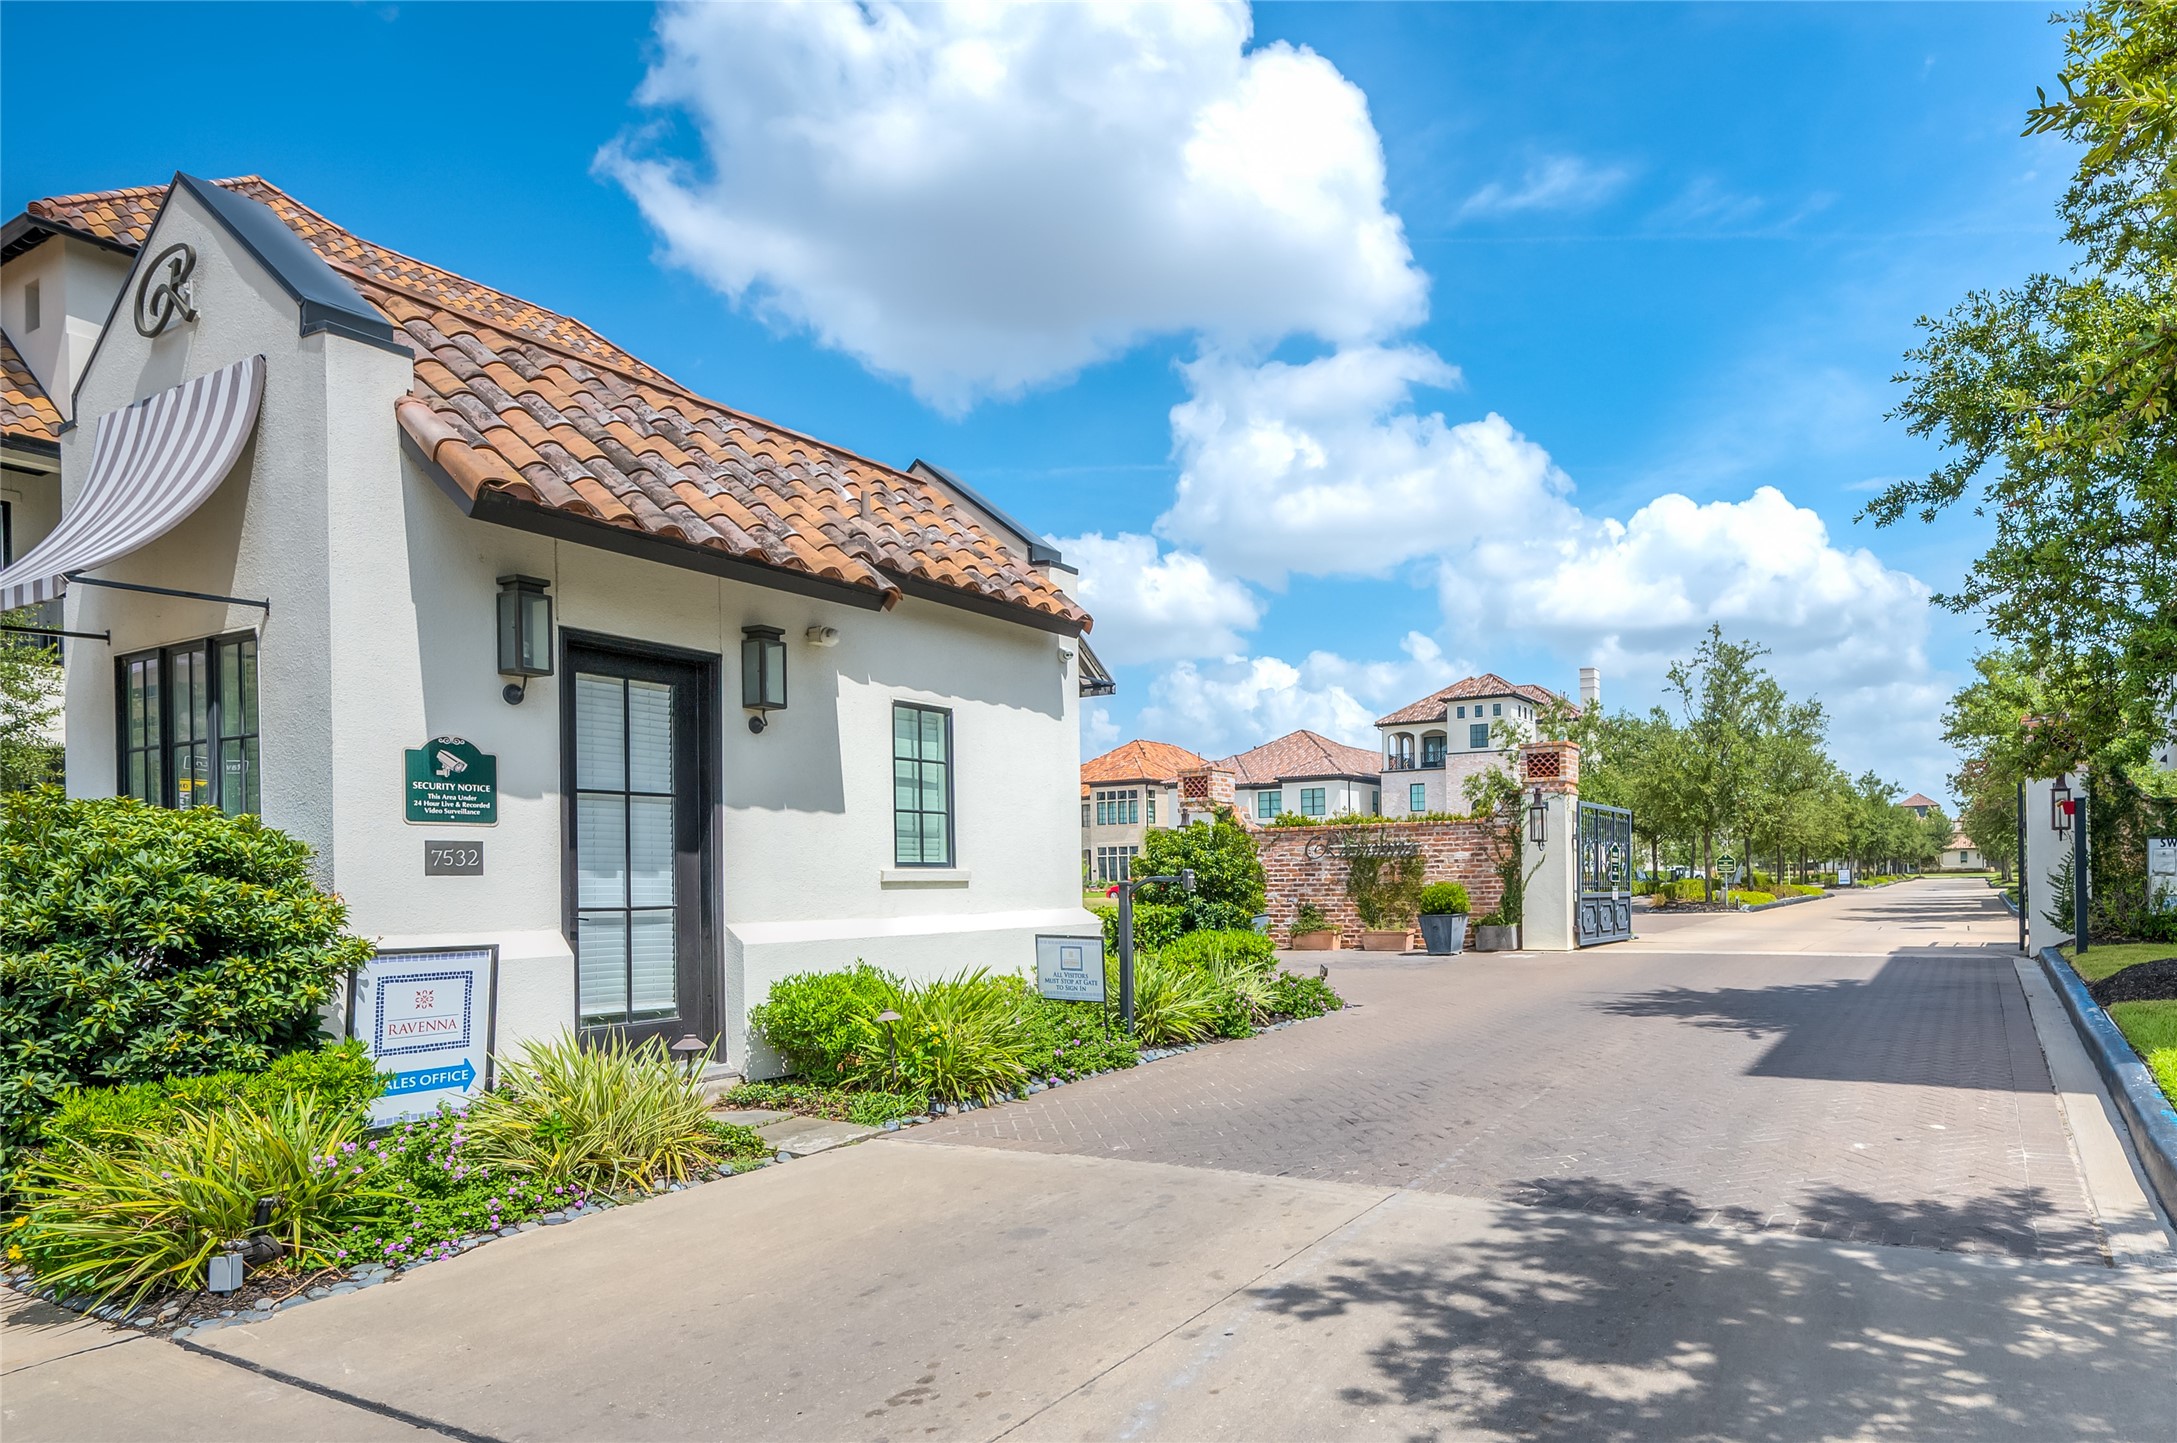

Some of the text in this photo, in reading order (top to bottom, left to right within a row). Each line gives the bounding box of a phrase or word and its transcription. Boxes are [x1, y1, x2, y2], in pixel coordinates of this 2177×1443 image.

[412, 781, 491, 793] SECURITY NOTICE
[427, 792, 441, 800] This
[442, 793, 457, 801] Area
[462, 801, 491, 809] Recorded
[424, 807, 481, 816] Video Surveillance
[430, 848, 479, 867] 7532
[388, 1018, 457, 1036] RAVENNA
[384, 1069, 469, 1090] ALES OFFICE
